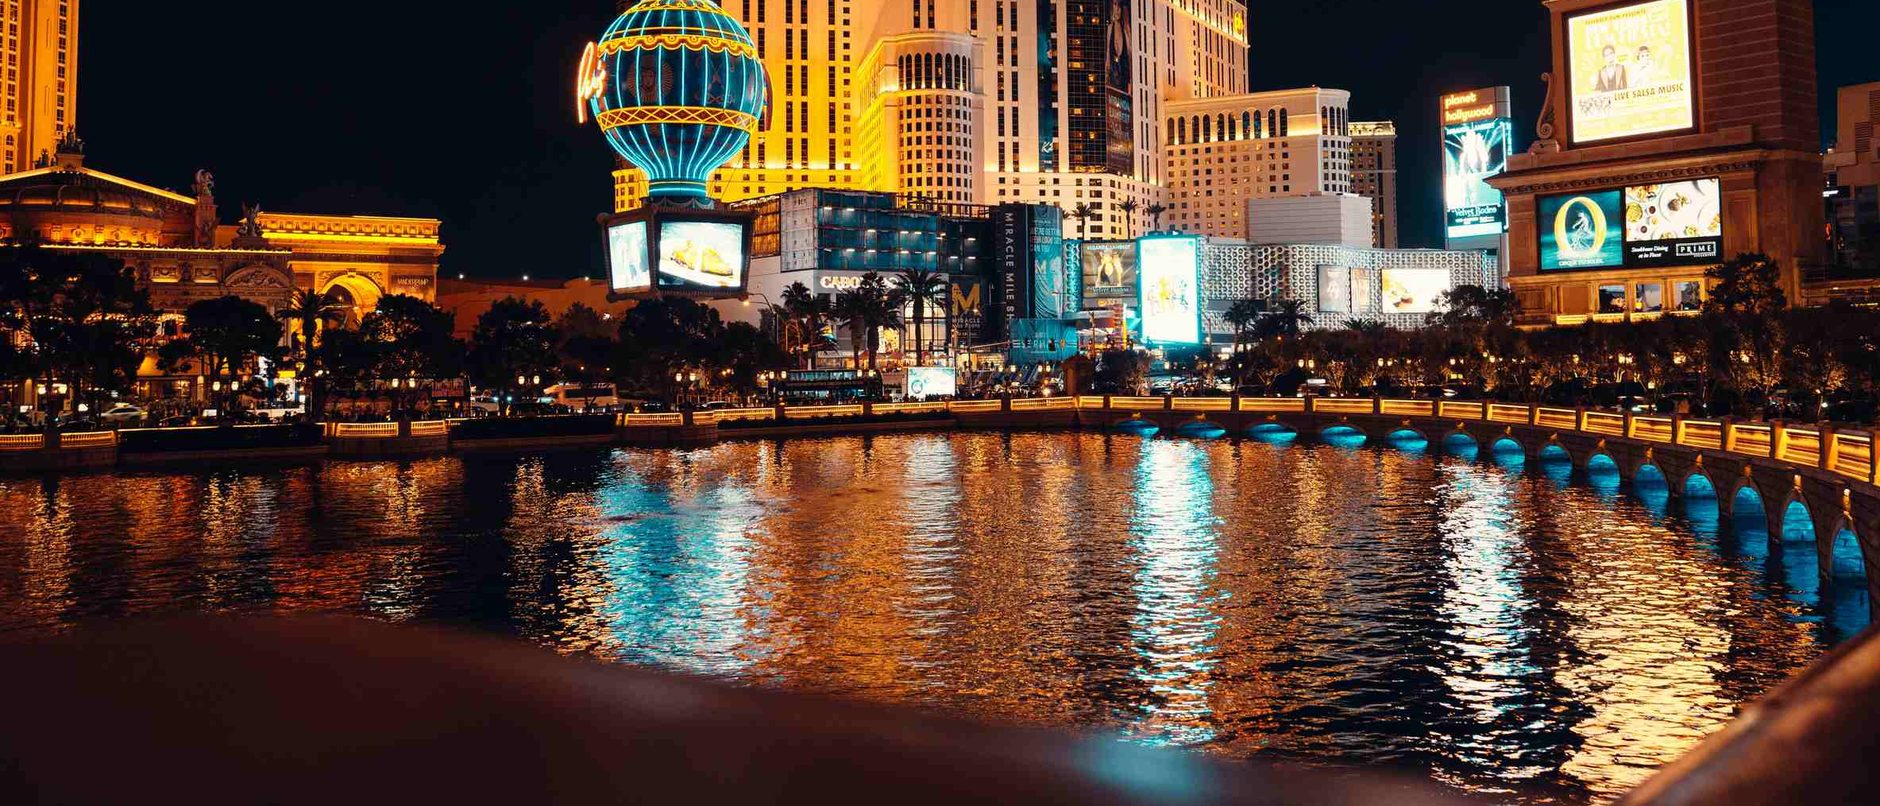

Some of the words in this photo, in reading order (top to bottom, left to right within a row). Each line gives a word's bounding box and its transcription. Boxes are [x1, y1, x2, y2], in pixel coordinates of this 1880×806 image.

[1445, 92, 1477, 109] planet
[1614, 91, 1629, 101] LIVE
[1632, 88, 1655, 98] SALSA
[1658, 83, 1684, 94] MUSIC
[1445, 104, 1494, 121] hollywood
[1005, 212, 1014, 267] MIRACLE
[1680, 244, 1712, 253] PRIME
[1006, 273, 1015, 300] MILE
